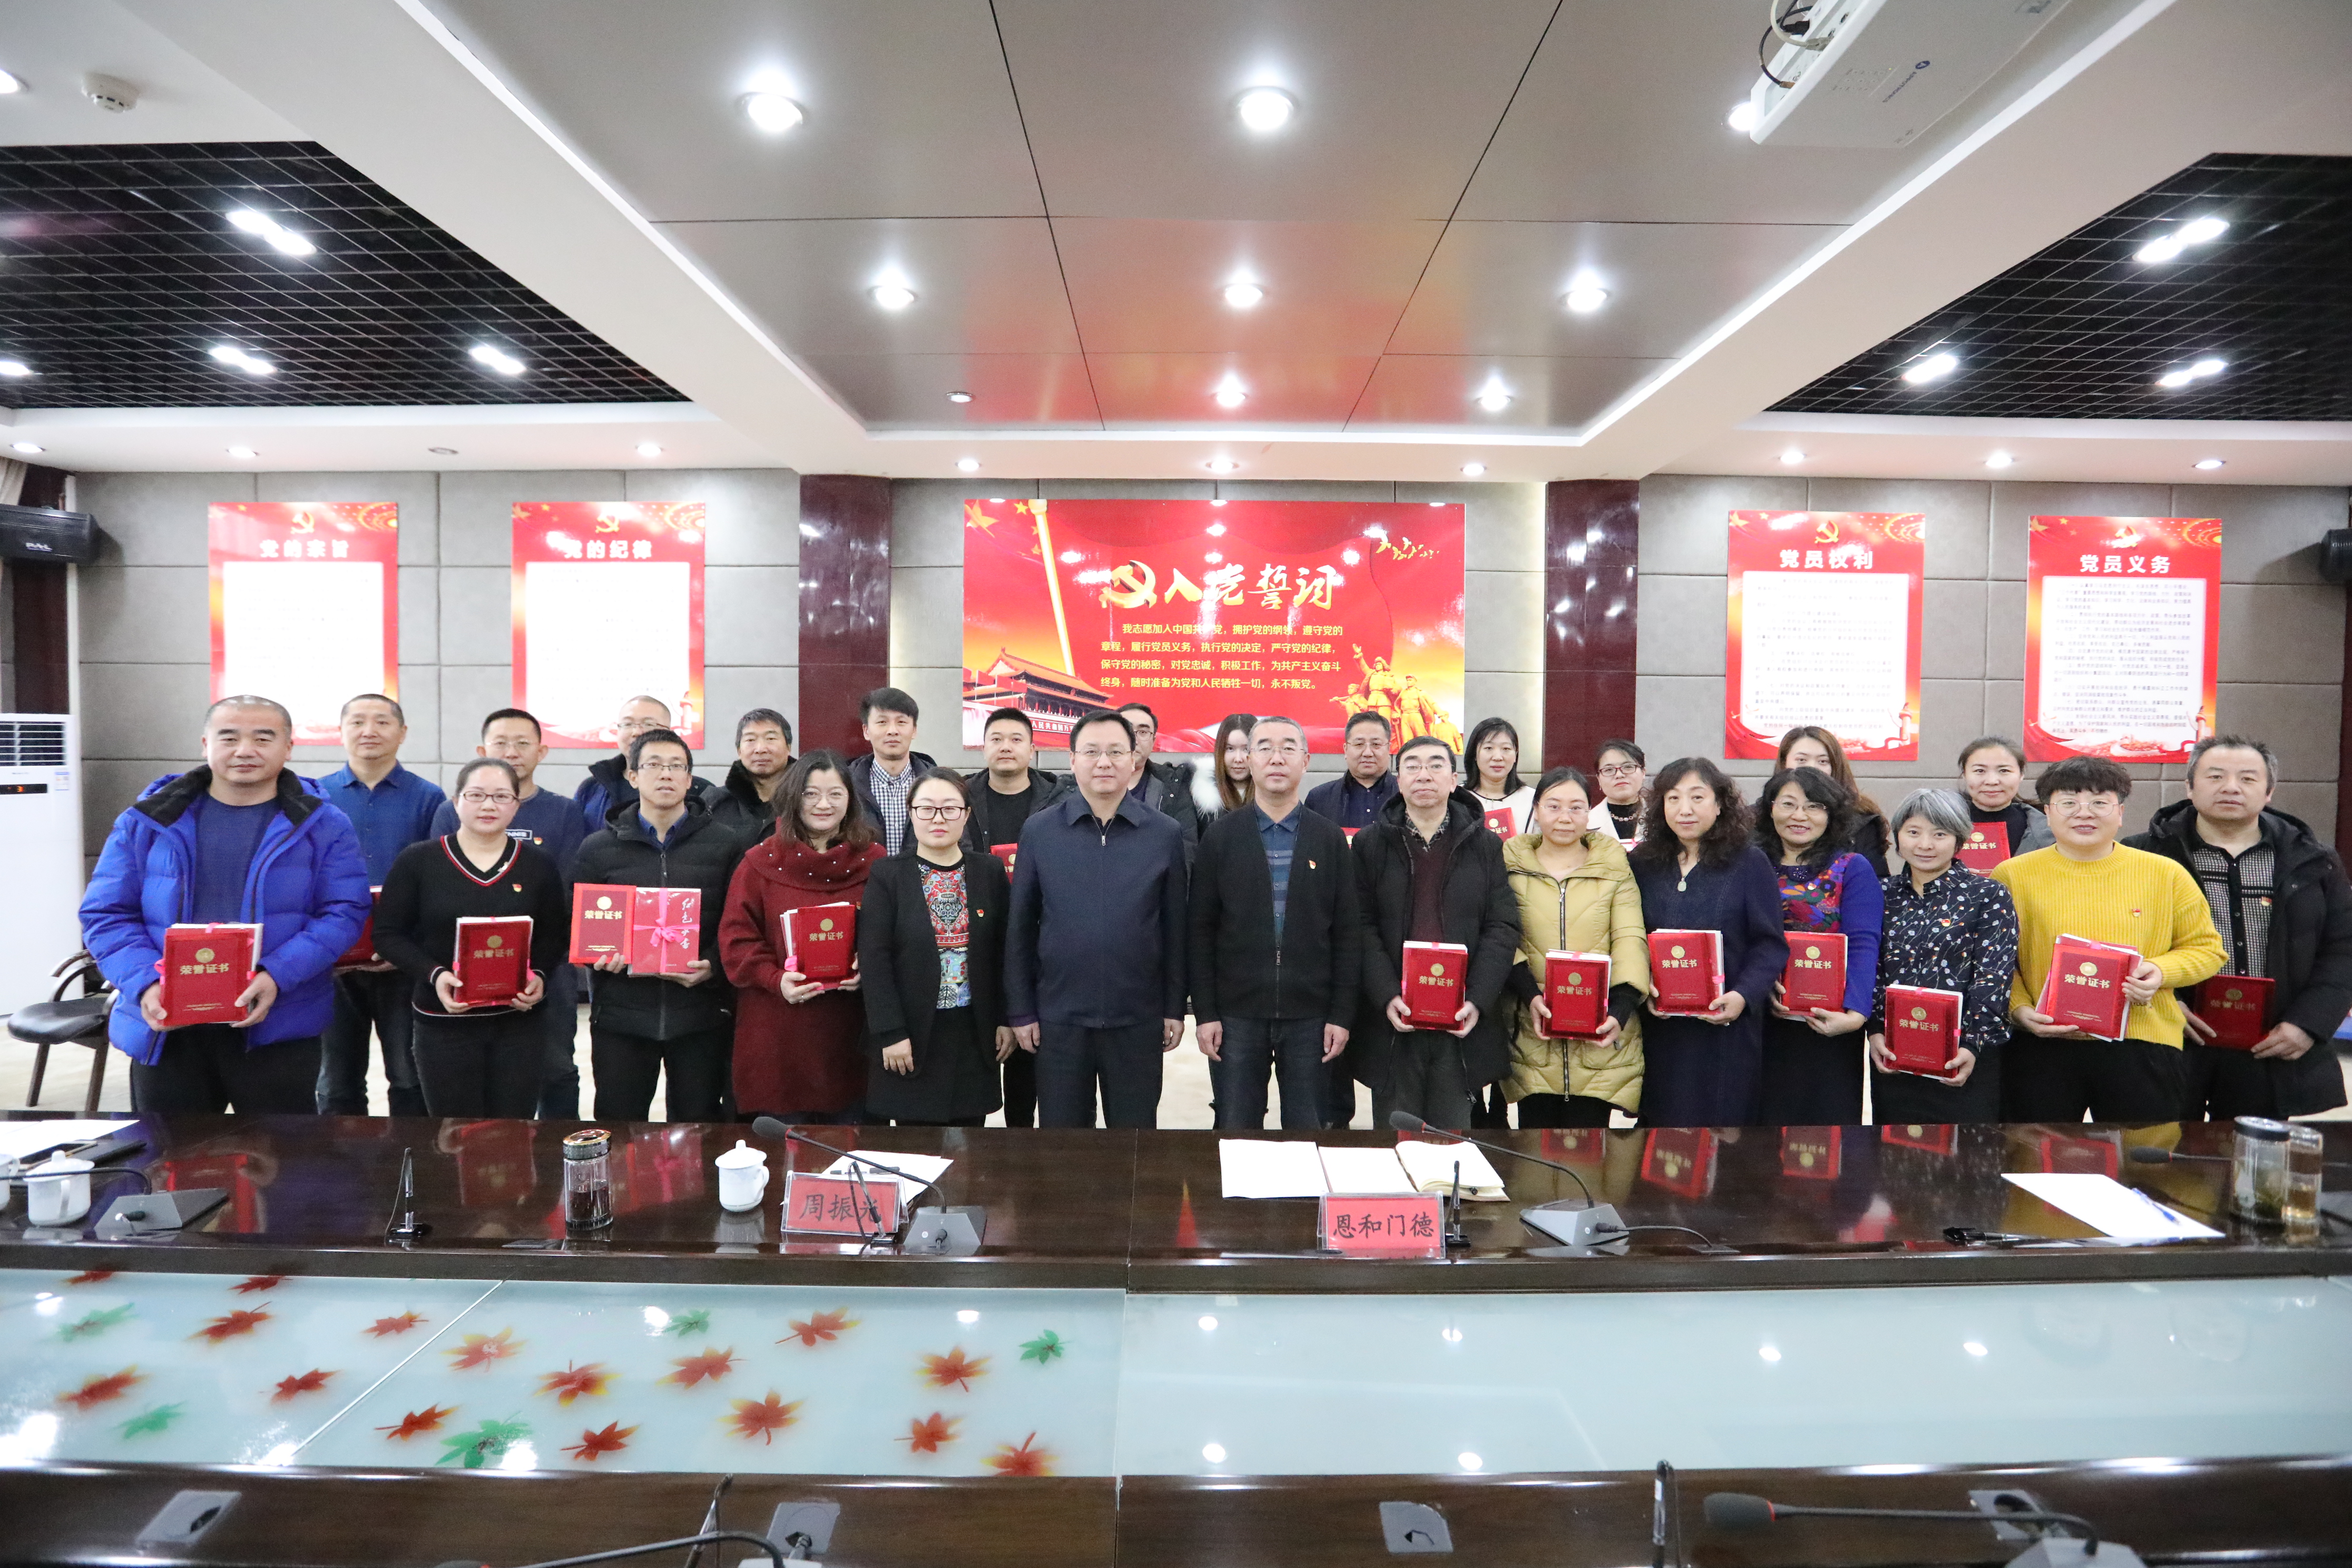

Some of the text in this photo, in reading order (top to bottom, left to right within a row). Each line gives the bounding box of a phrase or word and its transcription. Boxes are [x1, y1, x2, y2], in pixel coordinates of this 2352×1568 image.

[1780, 550, 1874, 570] 党员权利
[2080, 554, 2171, 574] 党员义务
[1164, 563, 1337, 610] 入党誓词
[1122, 623, 1343, 636] 我志愿加入中国共党，拥护党的纲领，遵守党的
[1101, 641, 1336, 654] 章程，履行党员义务，执行党的决定，严守党的纪律，
[1100, 659, 1341, 672] 保守党的秘密，对党忠诚，积极工作，为共产主义奋斗
[1100, 677, 1316, 689] 终身，随时准备为党和人民牺牲一切，永不叛党。
[584, 910, 623, 920] 荣誉证书
[809, 931, 844, 942] 荣誉证书
[473, 948, 515, 958] 荣誉证书
[180, 963, 230, 975] 荣誉证书
[1661, 959, 1698, 968] 荣誉证书
[1795, 959, 1832, 969] 荣誉证书
[1418, 975, 1454, 987] 荣誉证书
[2064, 974, 2111, 989] 荣誉证书
[1557, 985, 1592, 996] 荣誉证书
[1899, 1018, 1939, 1032] 荣誉证书
[1333, 1212, 1434, 1239] 恩和门德
